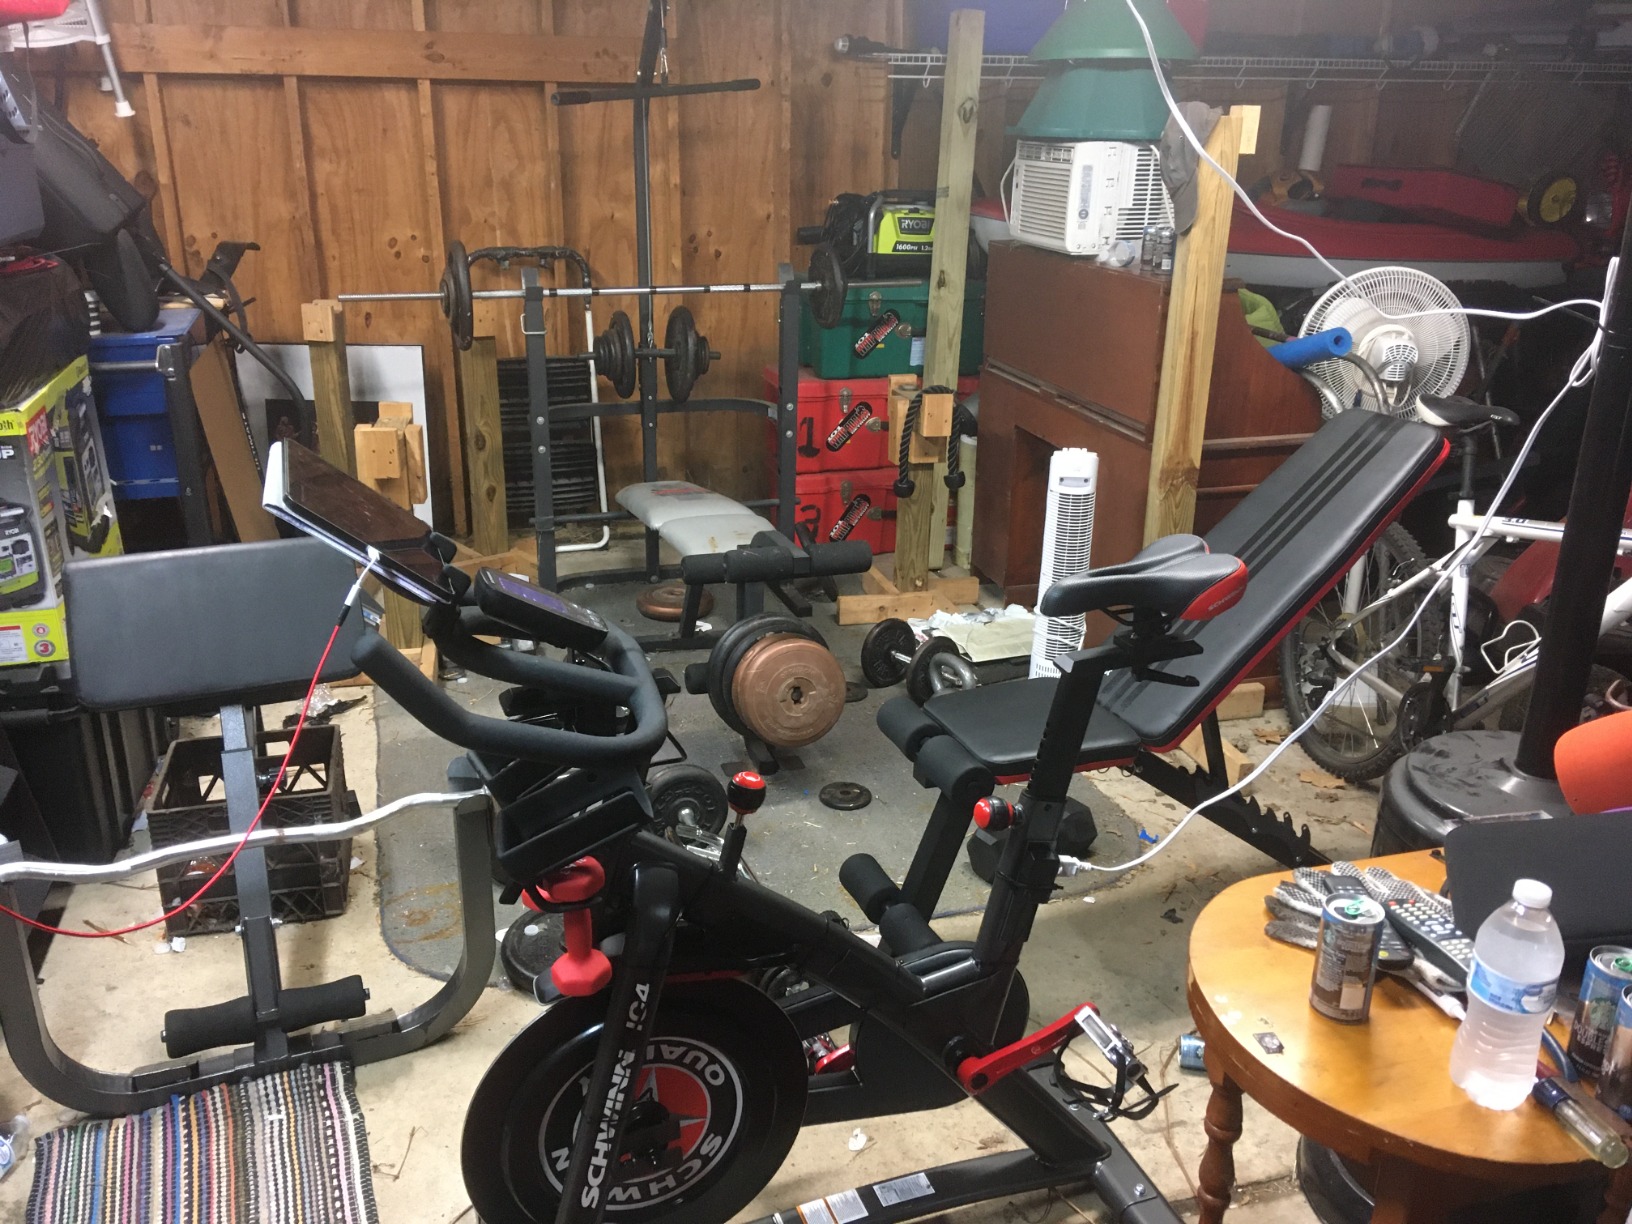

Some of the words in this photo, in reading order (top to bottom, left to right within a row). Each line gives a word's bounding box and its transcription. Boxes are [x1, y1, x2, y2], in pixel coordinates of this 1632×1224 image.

[901, 219, 931, 229] RYOBI
[798, 417, 820, 458] 1
[581, 1049, 637, 1209] SCHWINN
[551, 1133, 723, 1202] SCHWN
